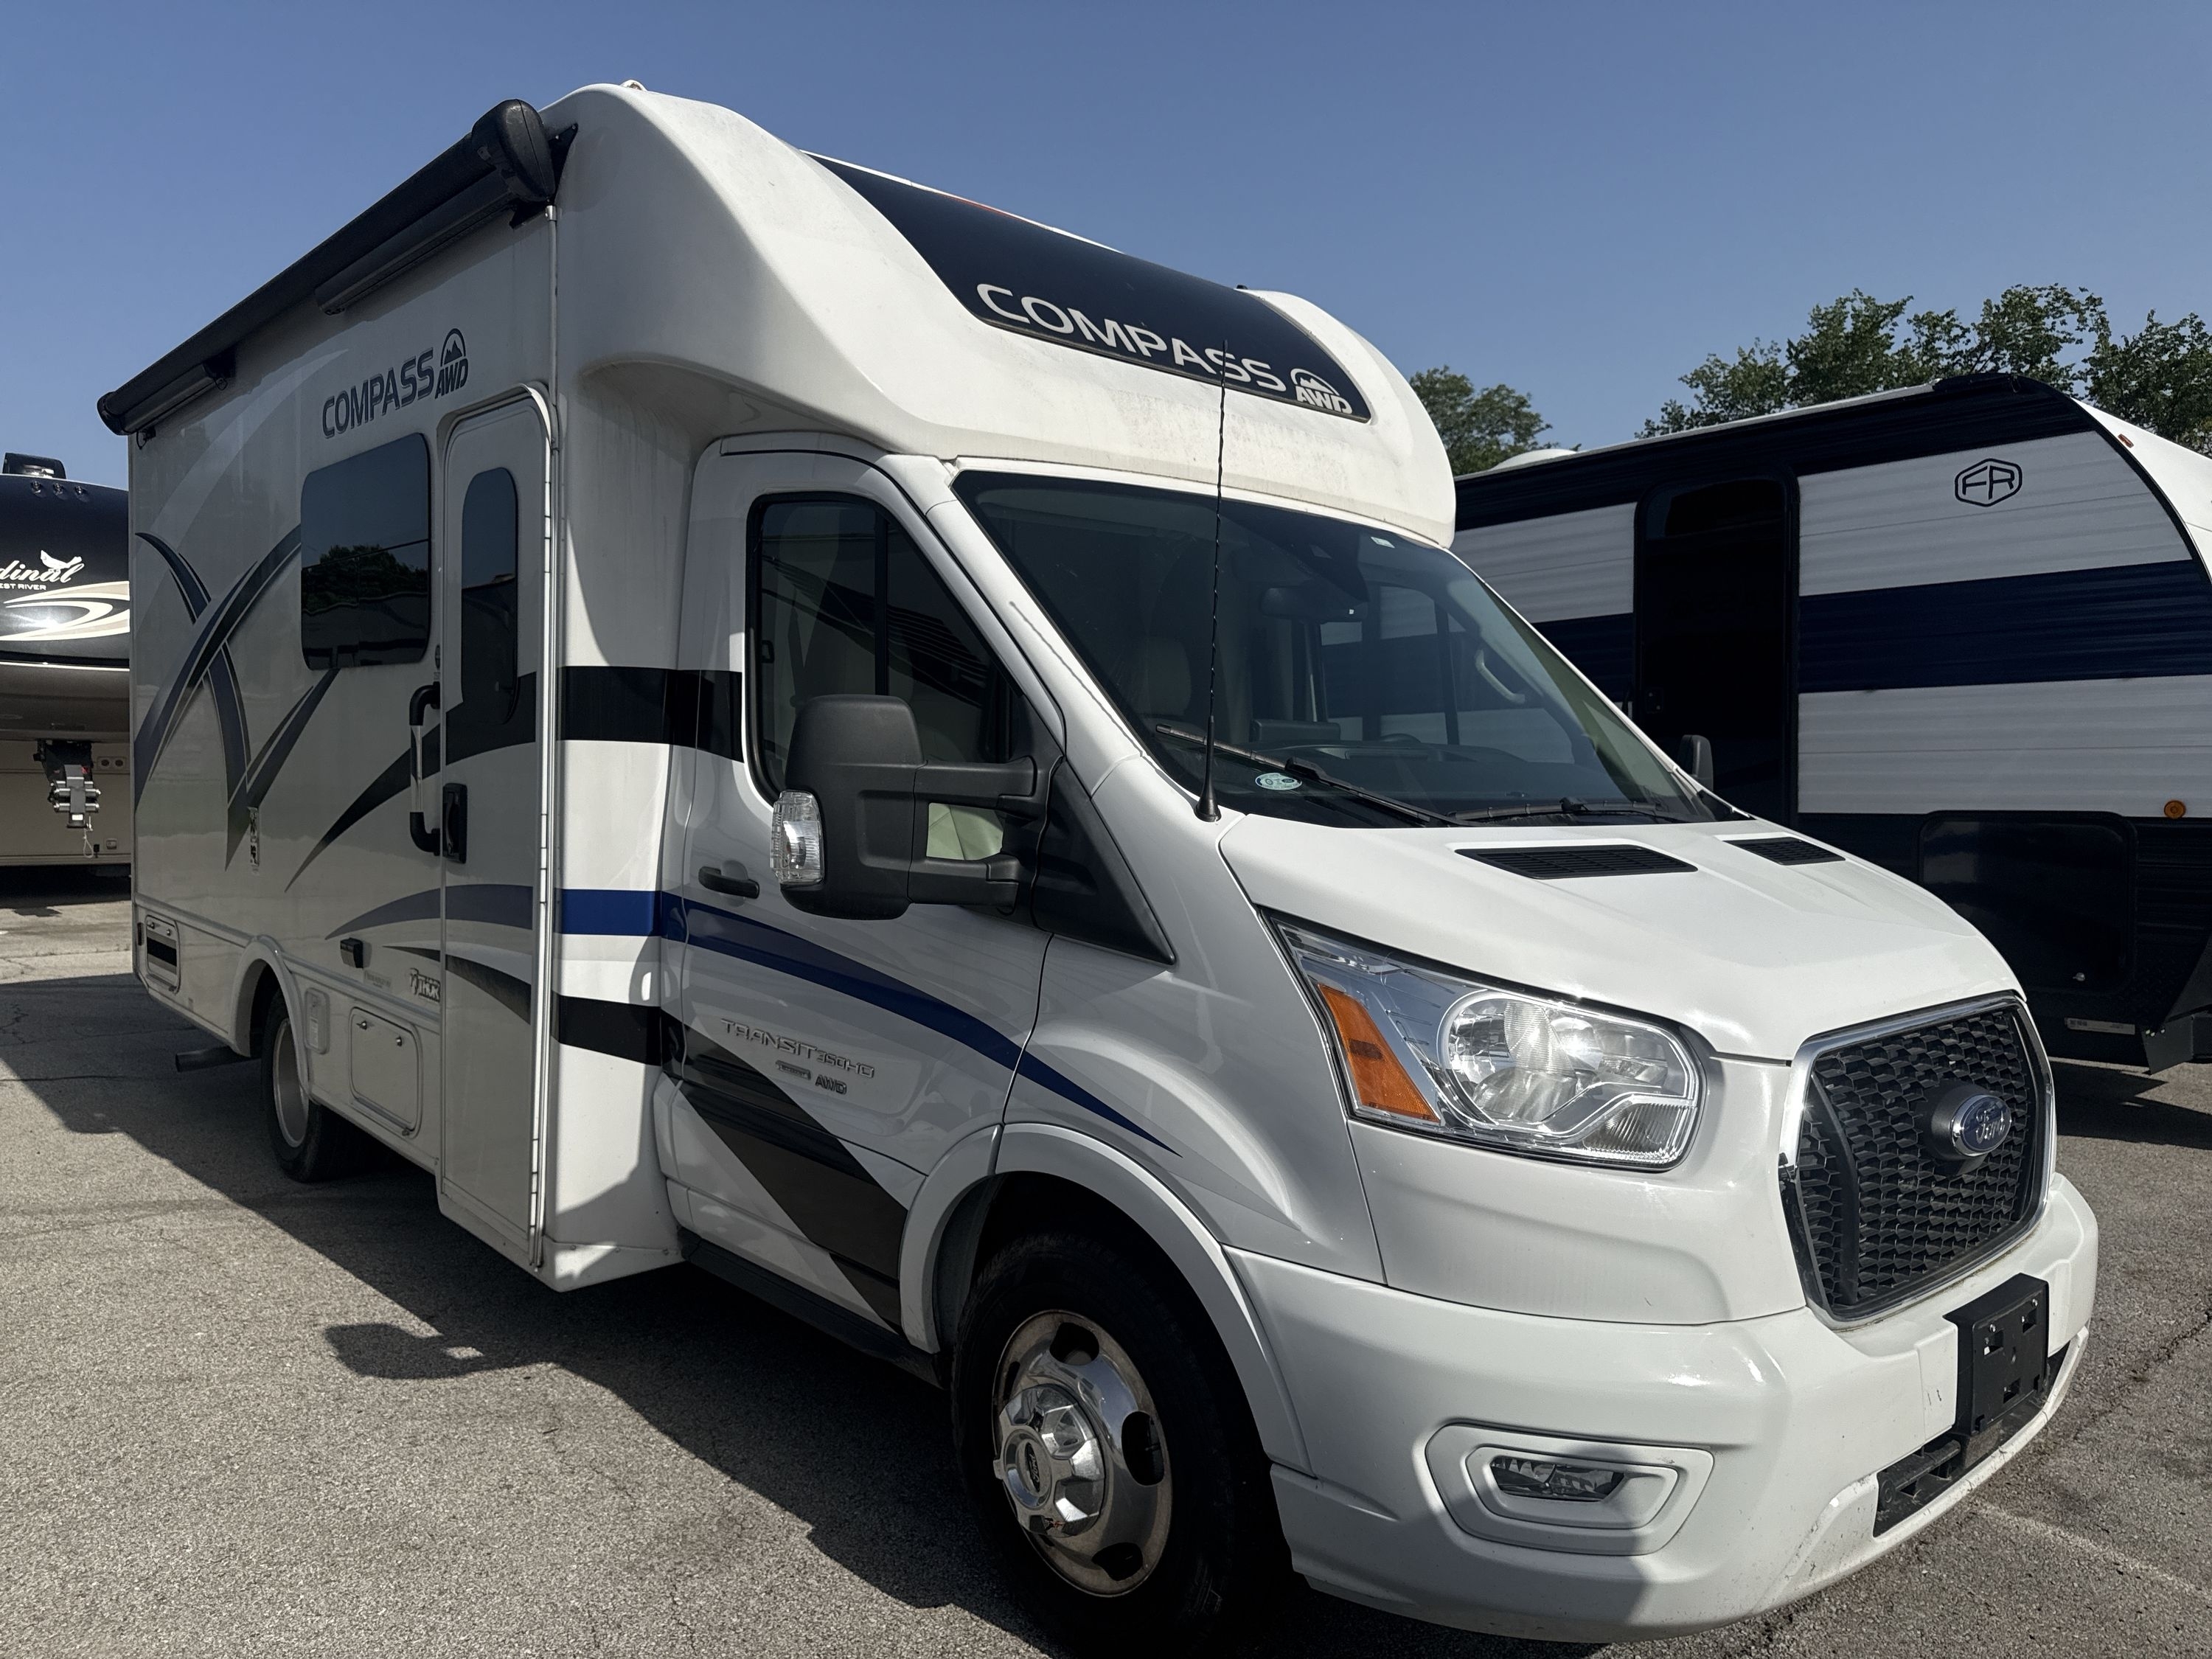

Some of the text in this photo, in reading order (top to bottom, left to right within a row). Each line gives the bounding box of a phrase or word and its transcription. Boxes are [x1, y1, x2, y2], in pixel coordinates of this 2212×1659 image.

[976, 283, 1352, 414] COMPASS AWD
[322, 347, 468, 439] COMPASS AWD
[1962, 465, 2015, 500] FR
[417, 975, 440, 1001] THOR
[720, 1018, 817, 1059] TRANSIT
[816, 1050, 874, 1078] 350HD
[815, 1074, 847, 1095] AWD
[1975, 1106, 2006, 1144] Ford
